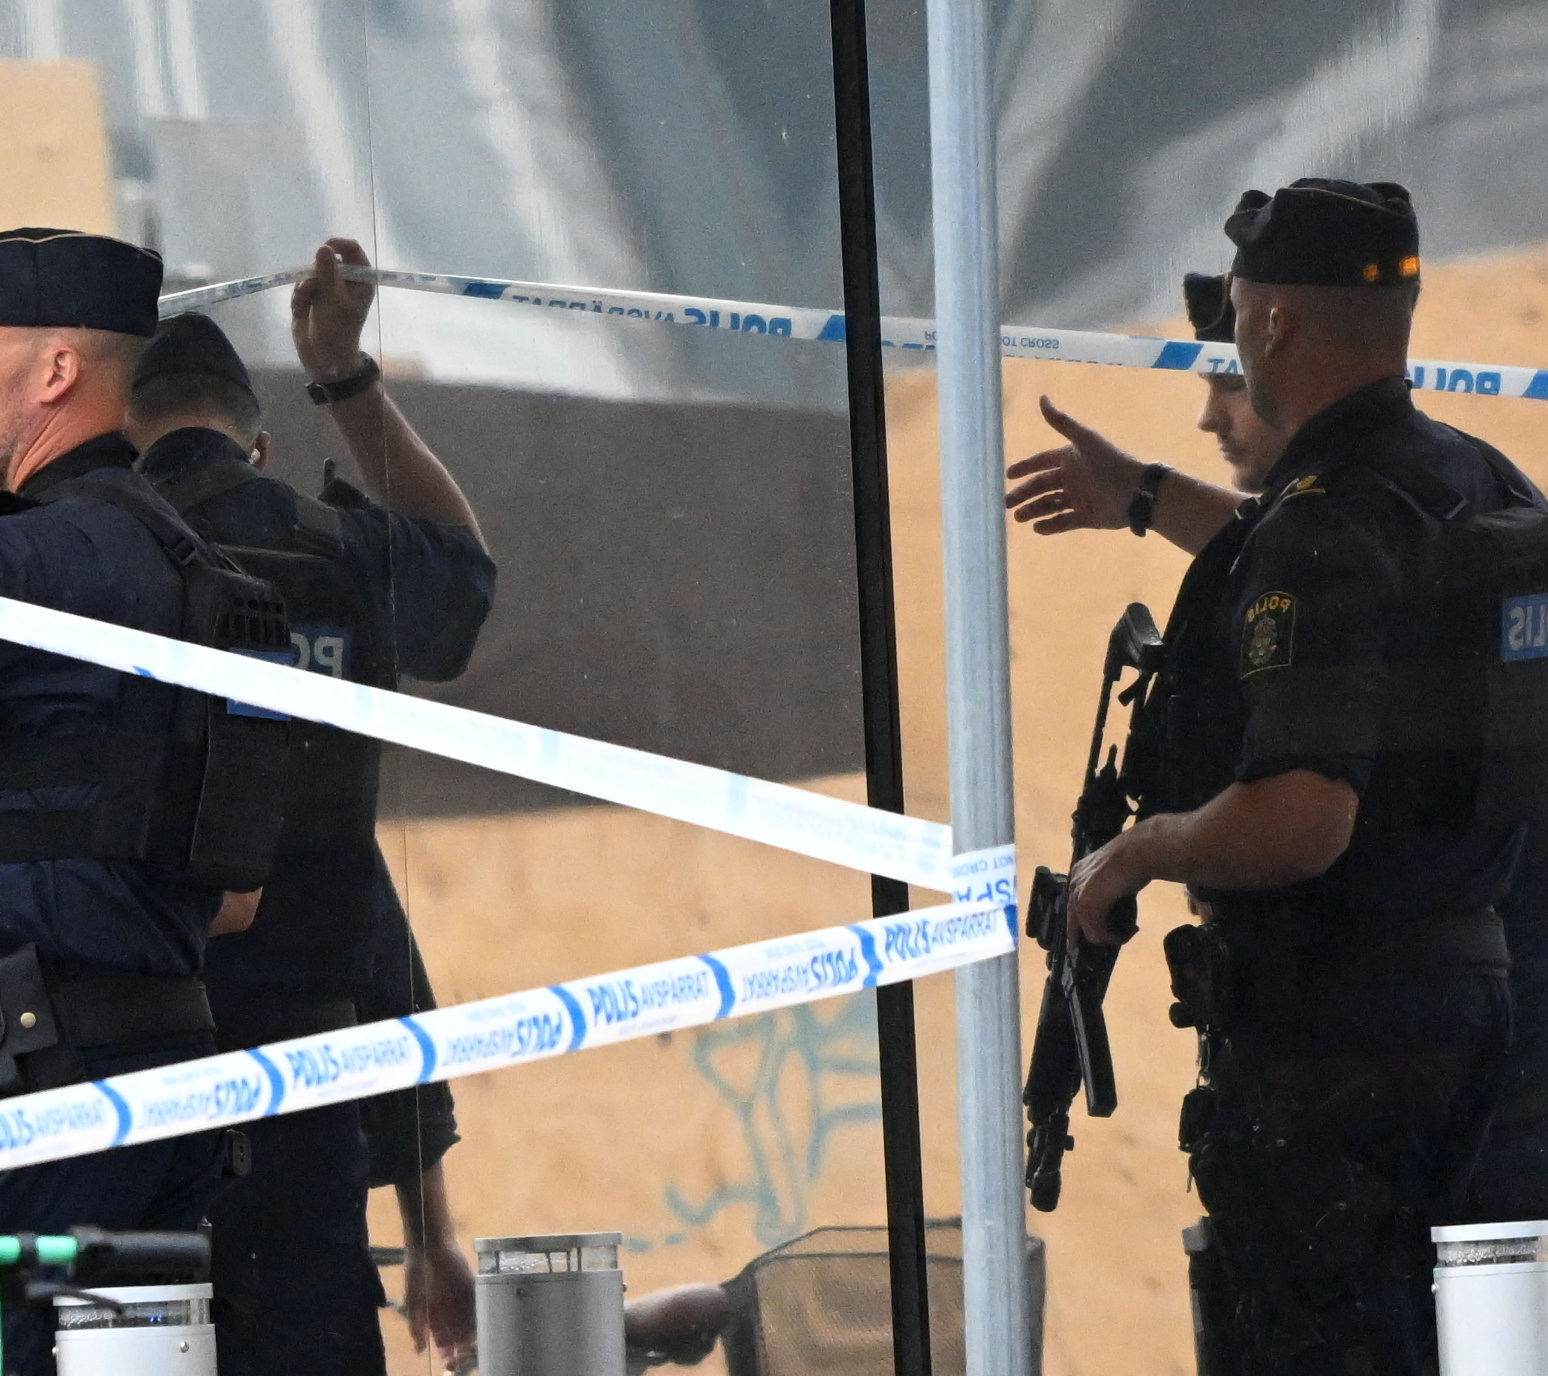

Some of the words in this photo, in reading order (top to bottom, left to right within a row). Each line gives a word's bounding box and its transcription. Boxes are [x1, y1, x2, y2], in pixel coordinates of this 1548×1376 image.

[883, 916, 932, 964] POLIS
[808, 947, 857, 994] POLIS
[587, 976, 640, 1028] POLIS
[517, 1010, 562, 1055] POLIS
[286, 1042, 339, 1092] POLIS
